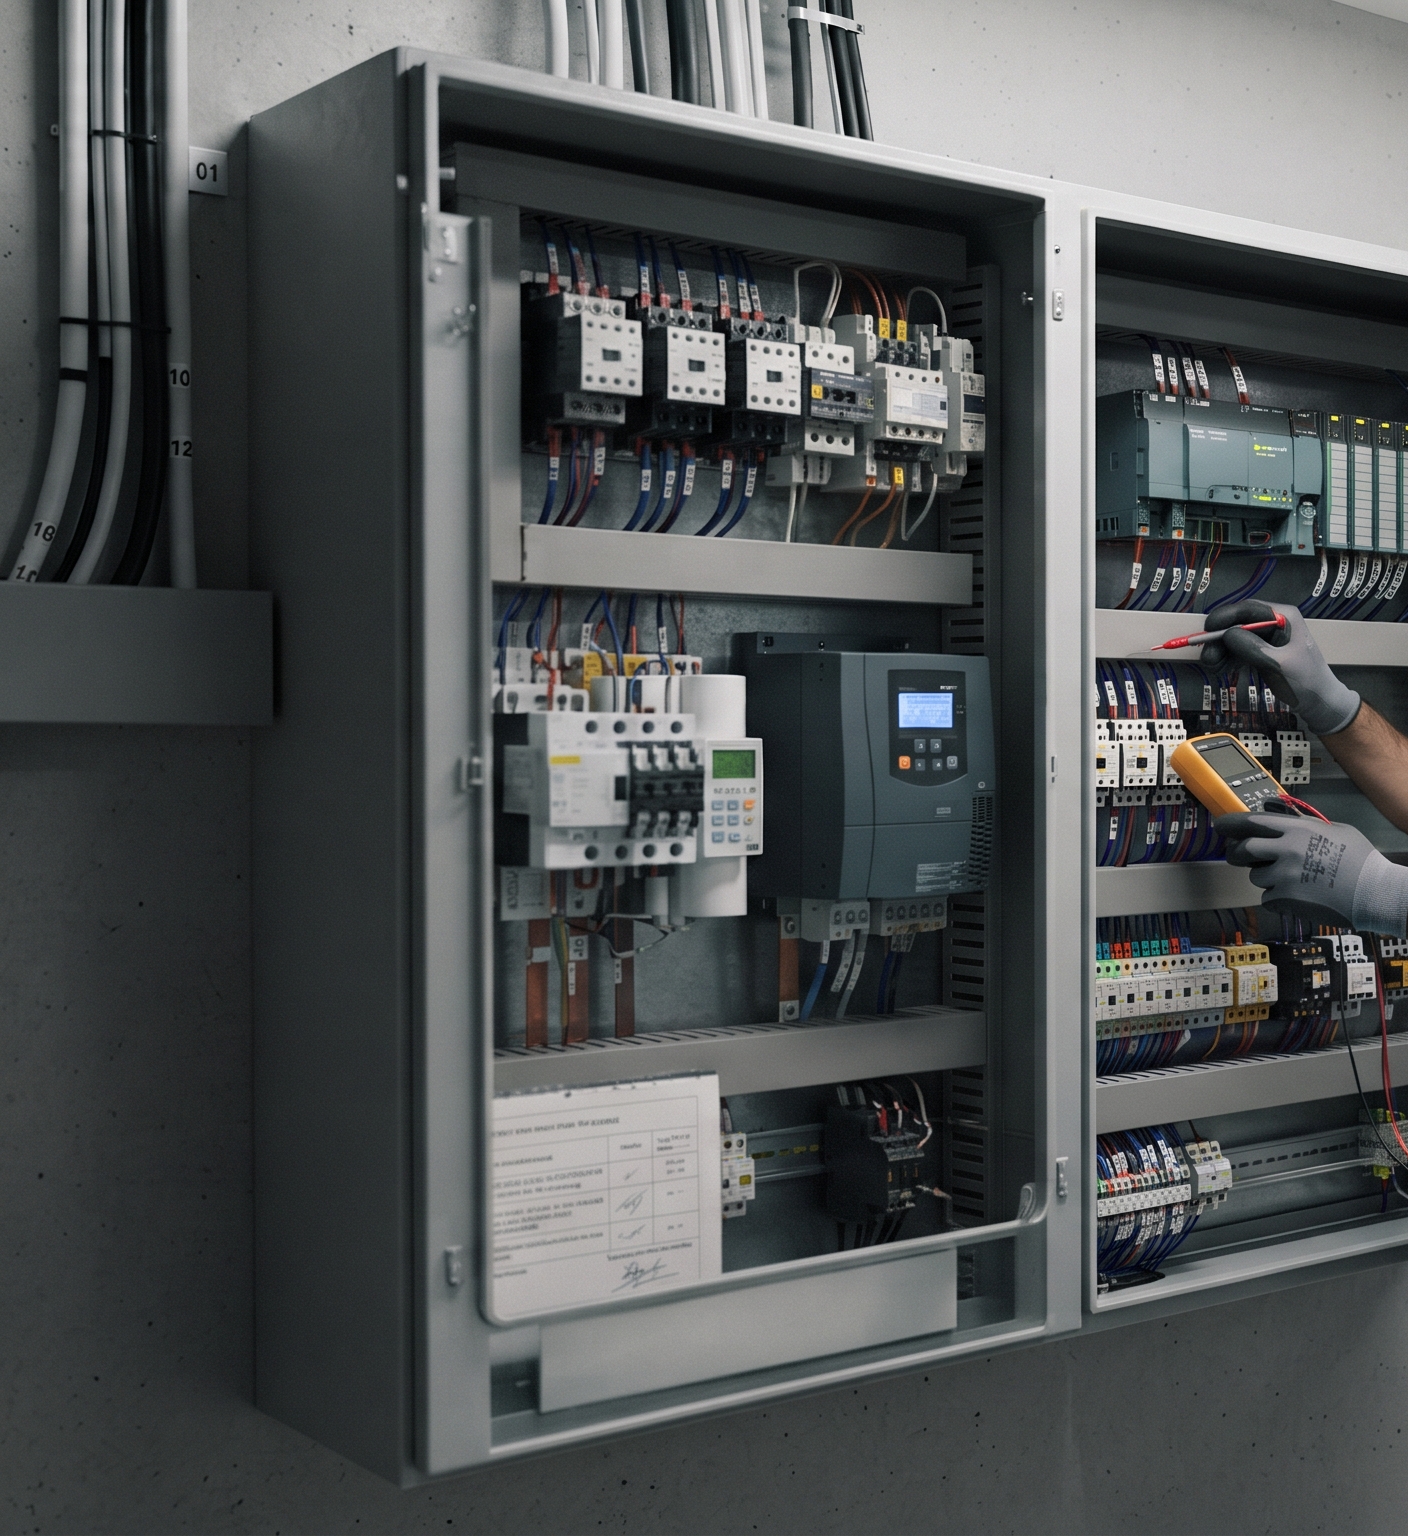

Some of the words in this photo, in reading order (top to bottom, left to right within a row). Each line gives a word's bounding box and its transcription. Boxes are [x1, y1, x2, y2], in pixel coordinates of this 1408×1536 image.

[196, 161, 217, 182] 01
[169, 368, 190, 387] 10
[171, 440, 192, 457] 12
